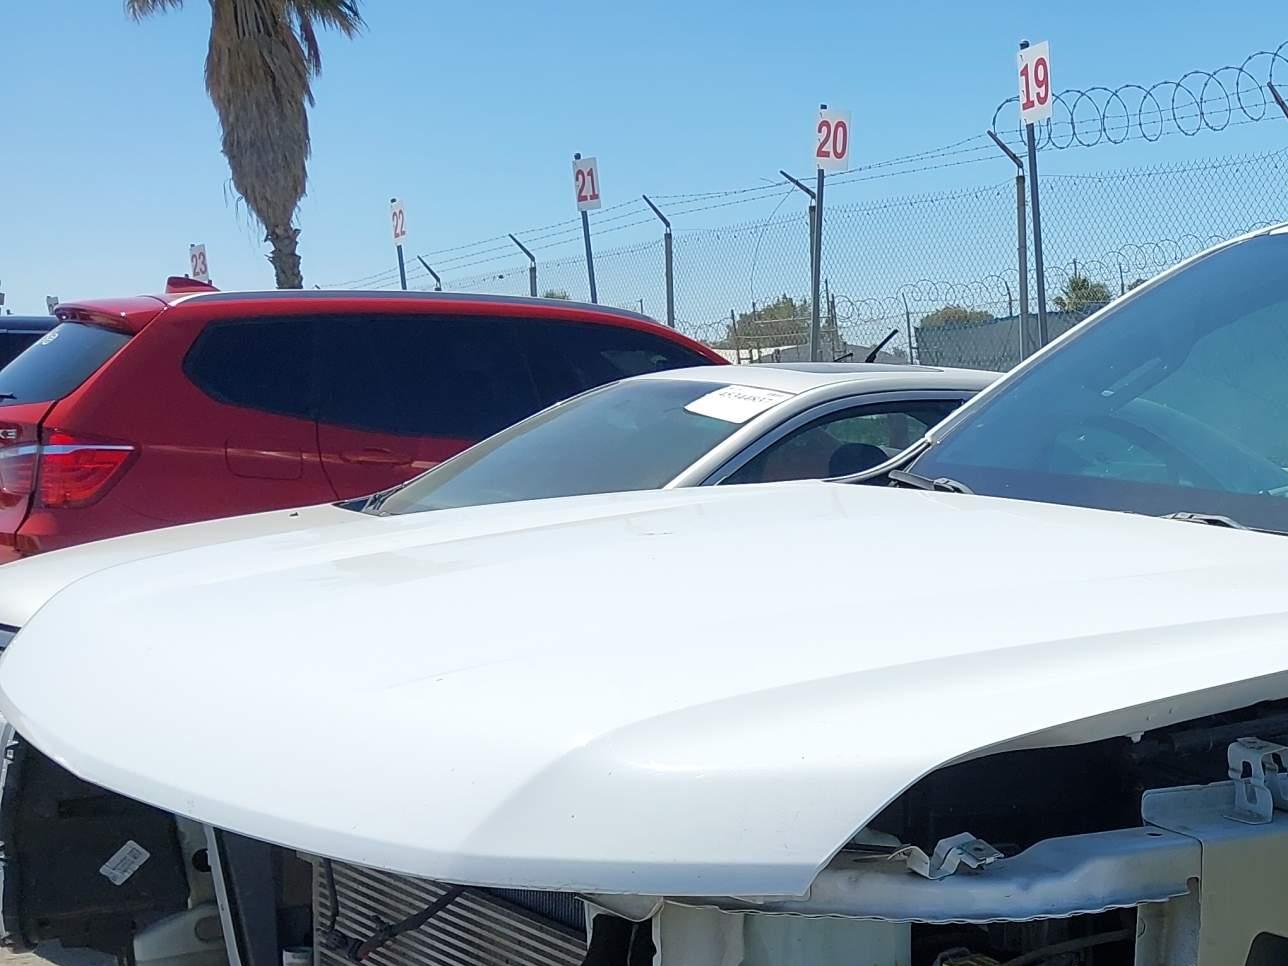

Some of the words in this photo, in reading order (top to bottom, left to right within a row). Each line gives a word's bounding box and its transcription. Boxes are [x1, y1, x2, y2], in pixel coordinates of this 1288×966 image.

[1020, 57, 1049, 111] 19
[816, 120, 848, 160] 20
[575, 167, 599, 201] 21
[391, 209, 406, 239] 22
[190, 251, 208, 277] 23
